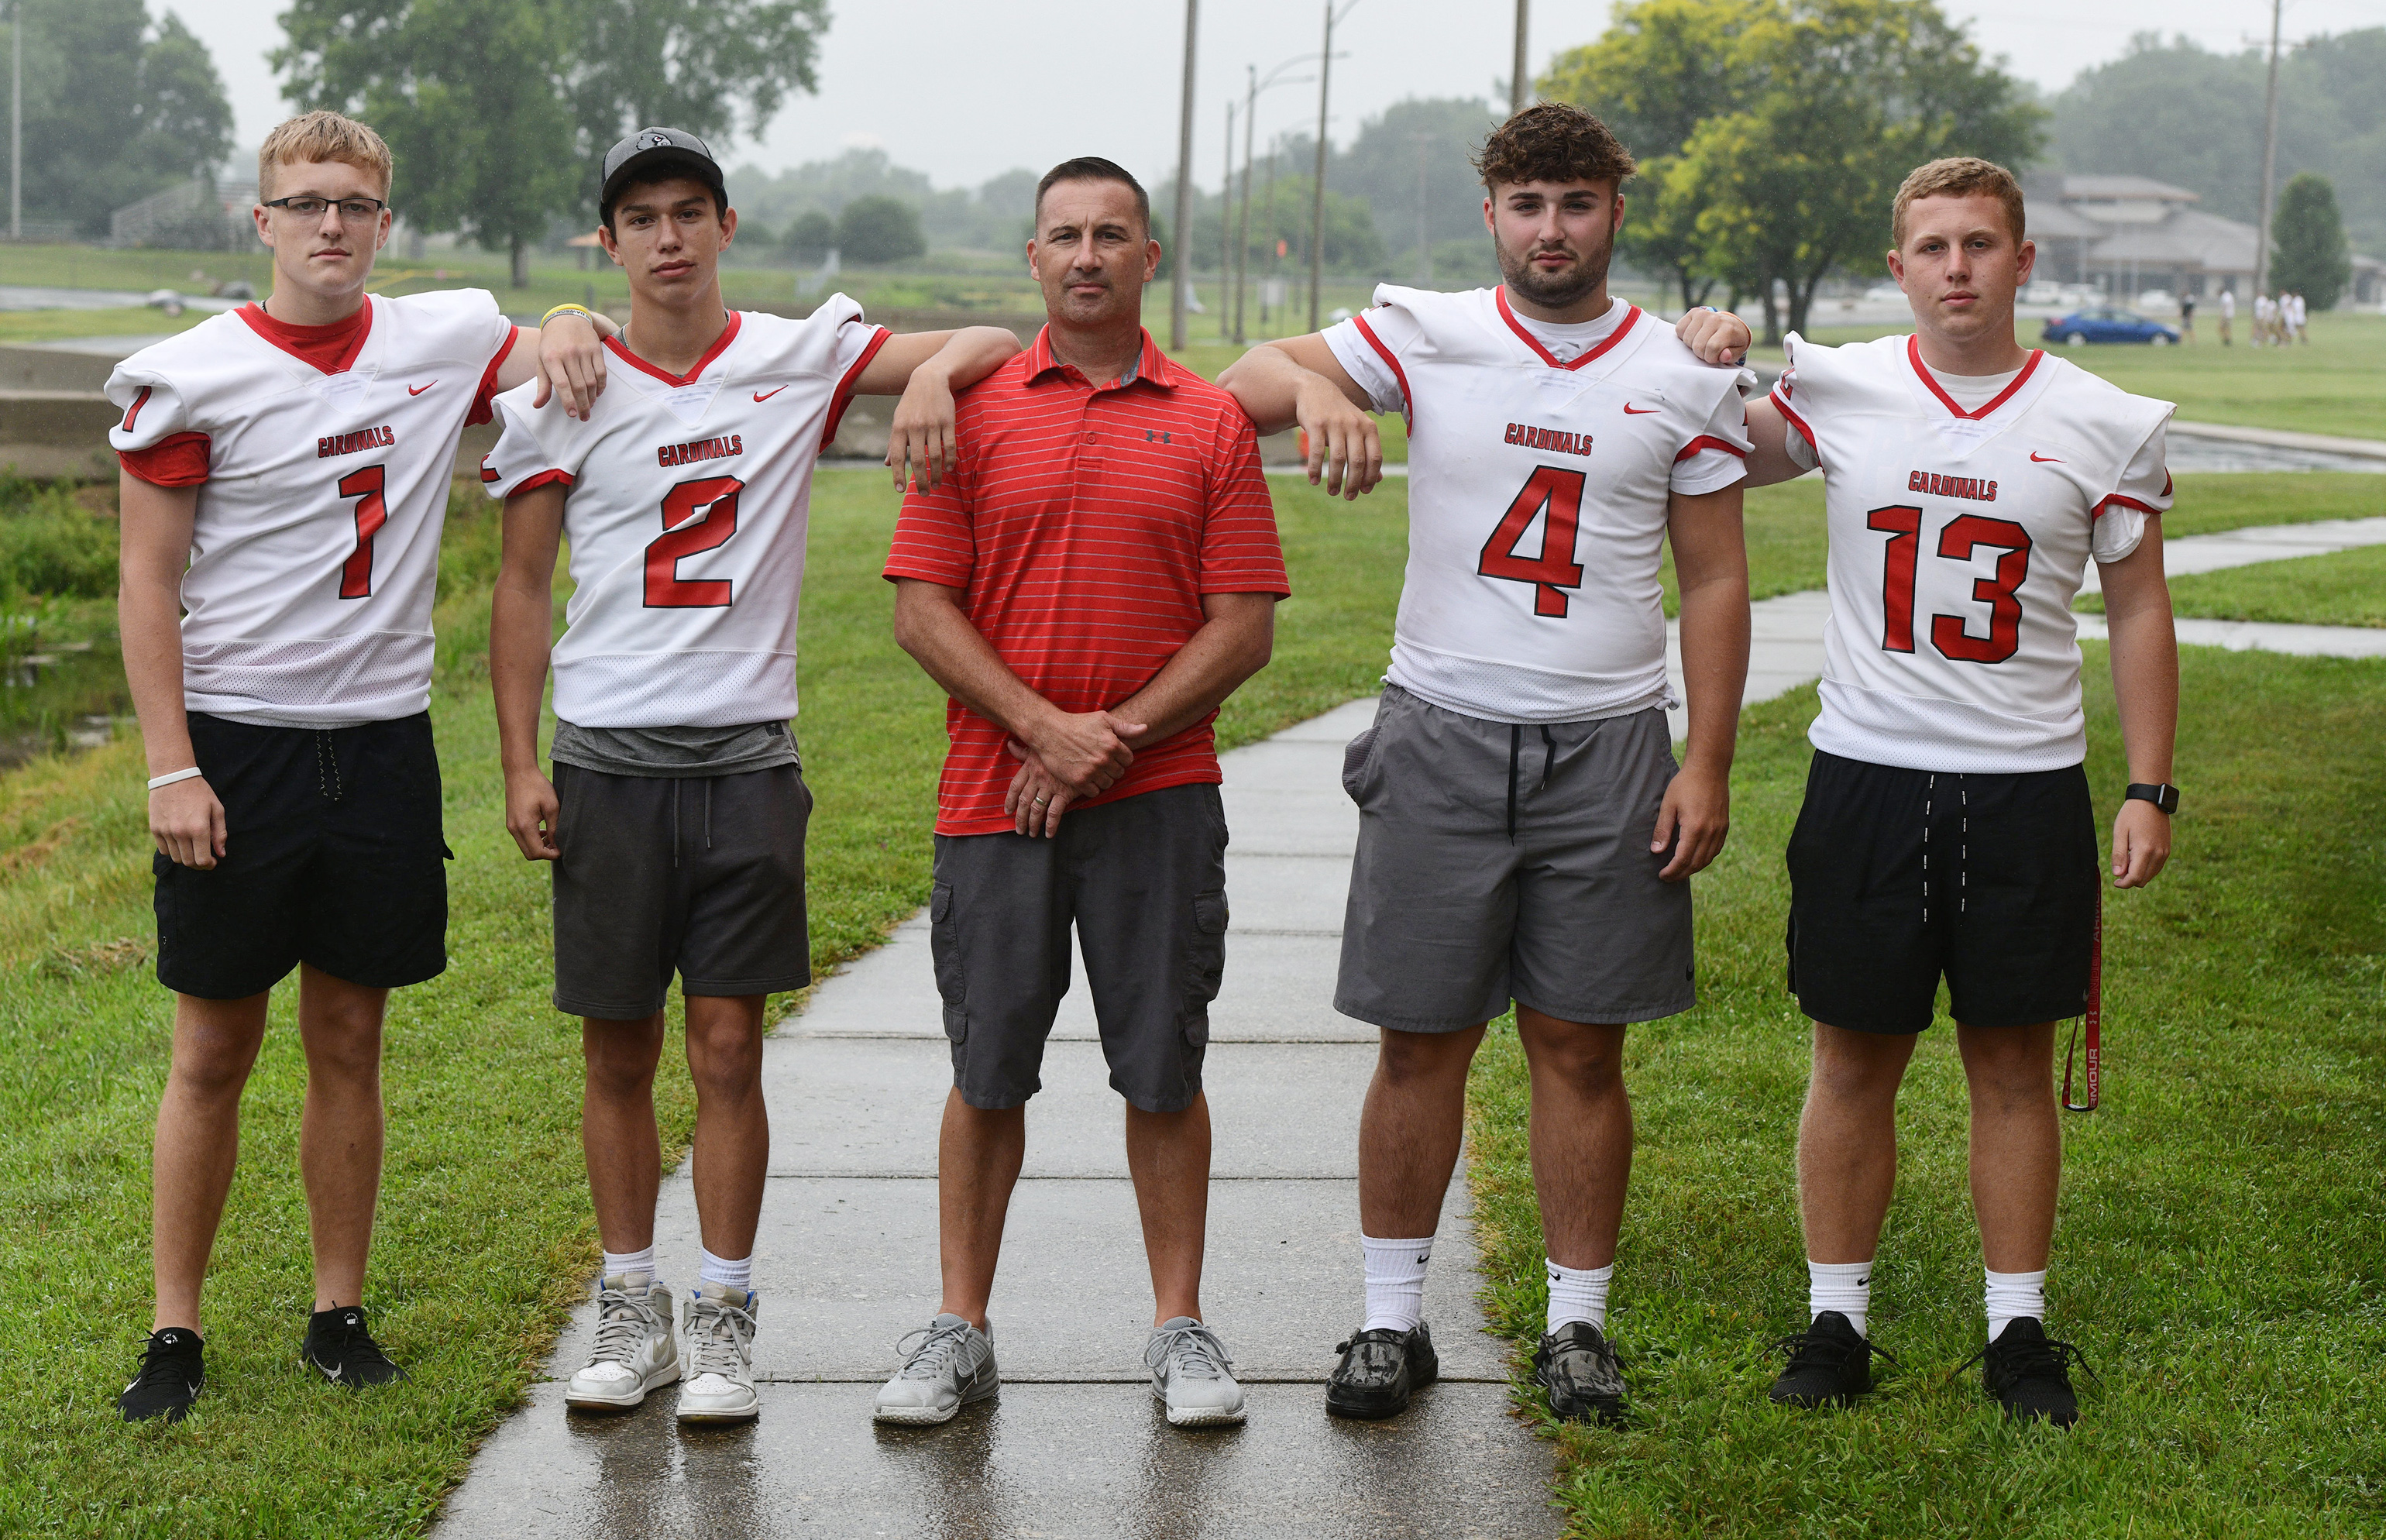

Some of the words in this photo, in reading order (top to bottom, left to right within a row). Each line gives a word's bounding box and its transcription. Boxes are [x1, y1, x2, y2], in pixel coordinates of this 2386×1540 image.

[318, 425, 395, 459] CARDINALS
[658, 435, 743, 468] CARDINALS
[1504, 422, 1594, 457] CARDINALS
[1908, 469, 1999, 503] CARDINALS
[338, 464, 388, 600] 1
[643, 474, 745, 608] 2
[1477, 464, 1587, 619] 4
[1867, 504, 2033, 664] 13
[2089, 1048, 2099, 1109] RMOUR
